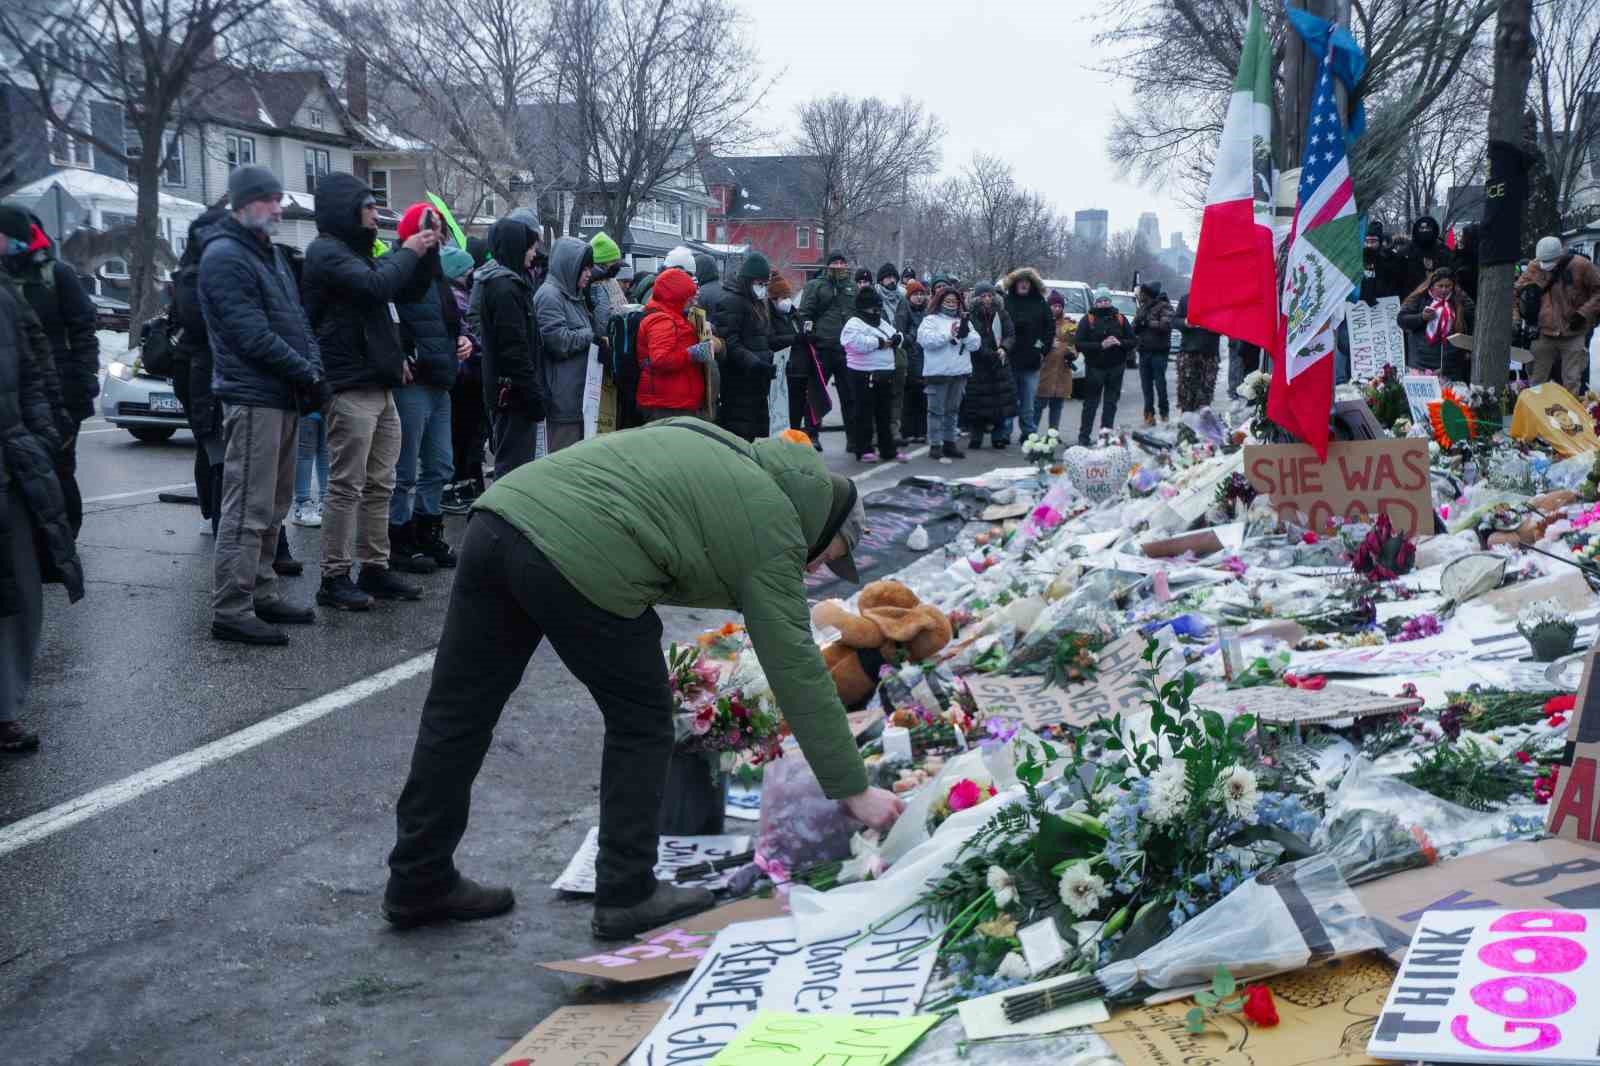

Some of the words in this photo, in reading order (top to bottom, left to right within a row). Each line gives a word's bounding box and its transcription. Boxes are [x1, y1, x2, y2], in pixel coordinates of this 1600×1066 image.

[1351, 304, 1368, 331] VIVA
[1353, 331, 1370, 345] LA
[1353, 345, 1373, 374] RAZA
[1085, 467, 1111, 480] LOVE
[1251, 456, 1325, 495] SHE
[1337, 449, 1427, 492] WAS
[855, 913, 932, 974] SAY
[694, 938, 801, 1017] RENEE
[1375, 926, 1475, 1042] THINK
[1450, 911, 1588, 1053] GOOD
[521, 1010, 592, 1055] RENEE
[560, 1025, 606, 1051] FOR
